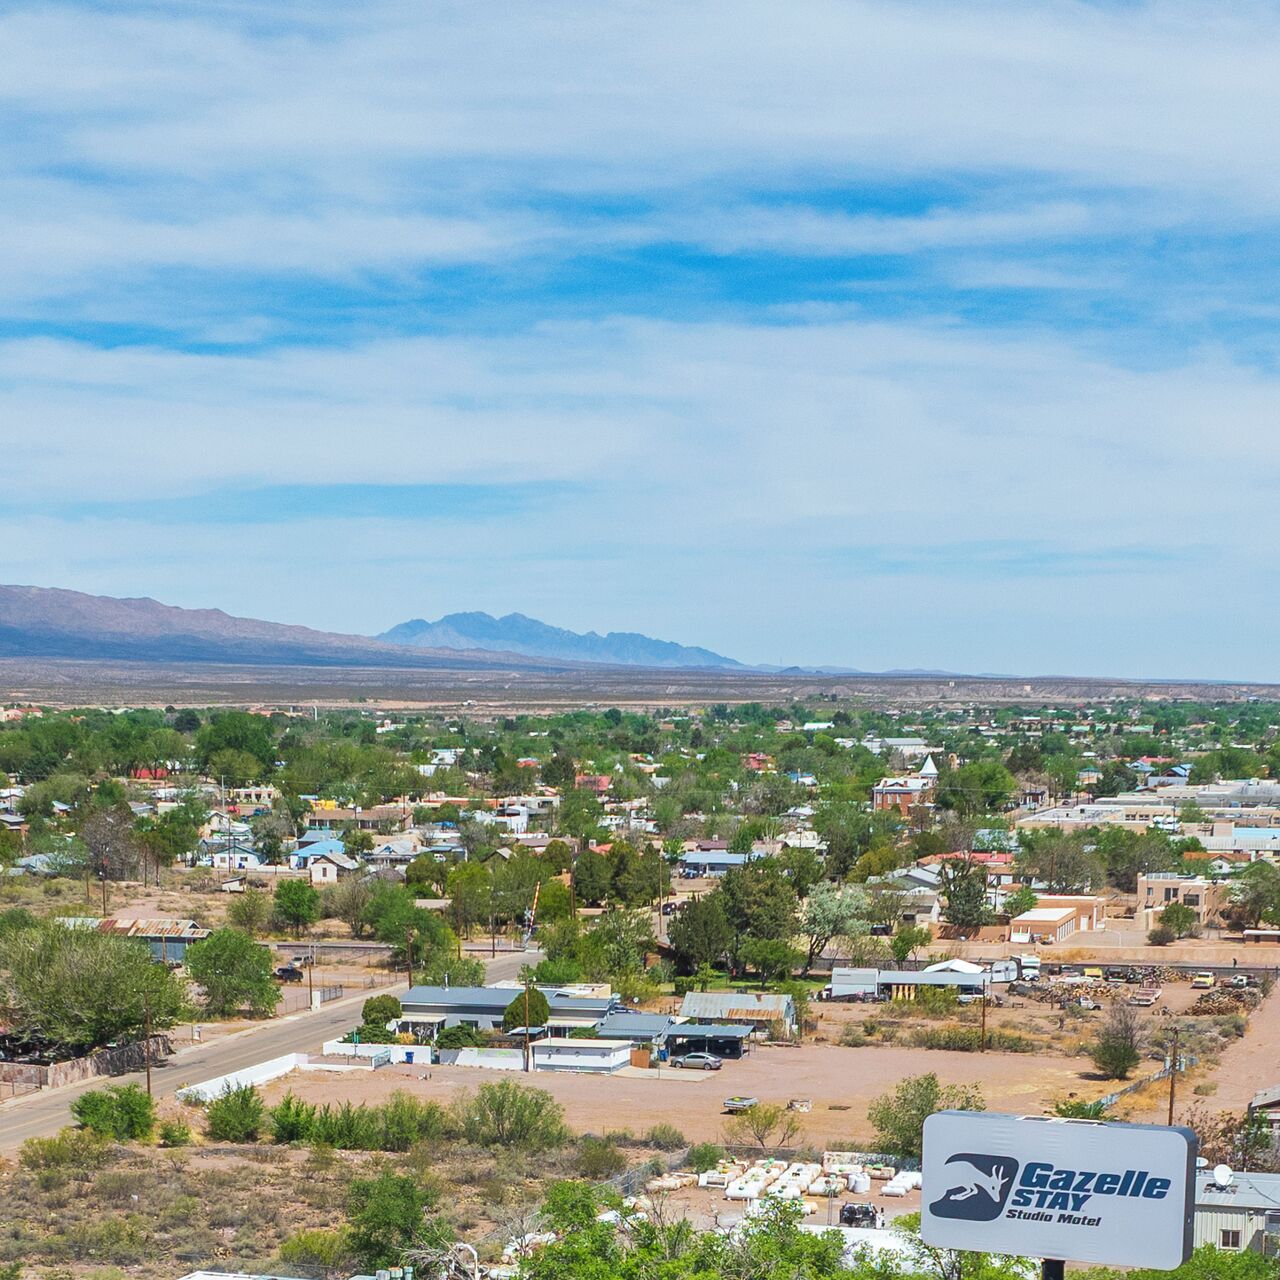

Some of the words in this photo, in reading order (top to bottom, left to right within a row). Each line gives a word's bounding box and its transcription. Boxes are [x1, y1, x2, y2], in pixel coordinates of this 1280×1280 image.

[1019, 1162, 1172, 1200] Gazelle
[1011, 1188, 1093, 1212] STAY
[1006, 1209, 1053, 1223] Studio
[1057, 1213, 1102, 1227] Motel
